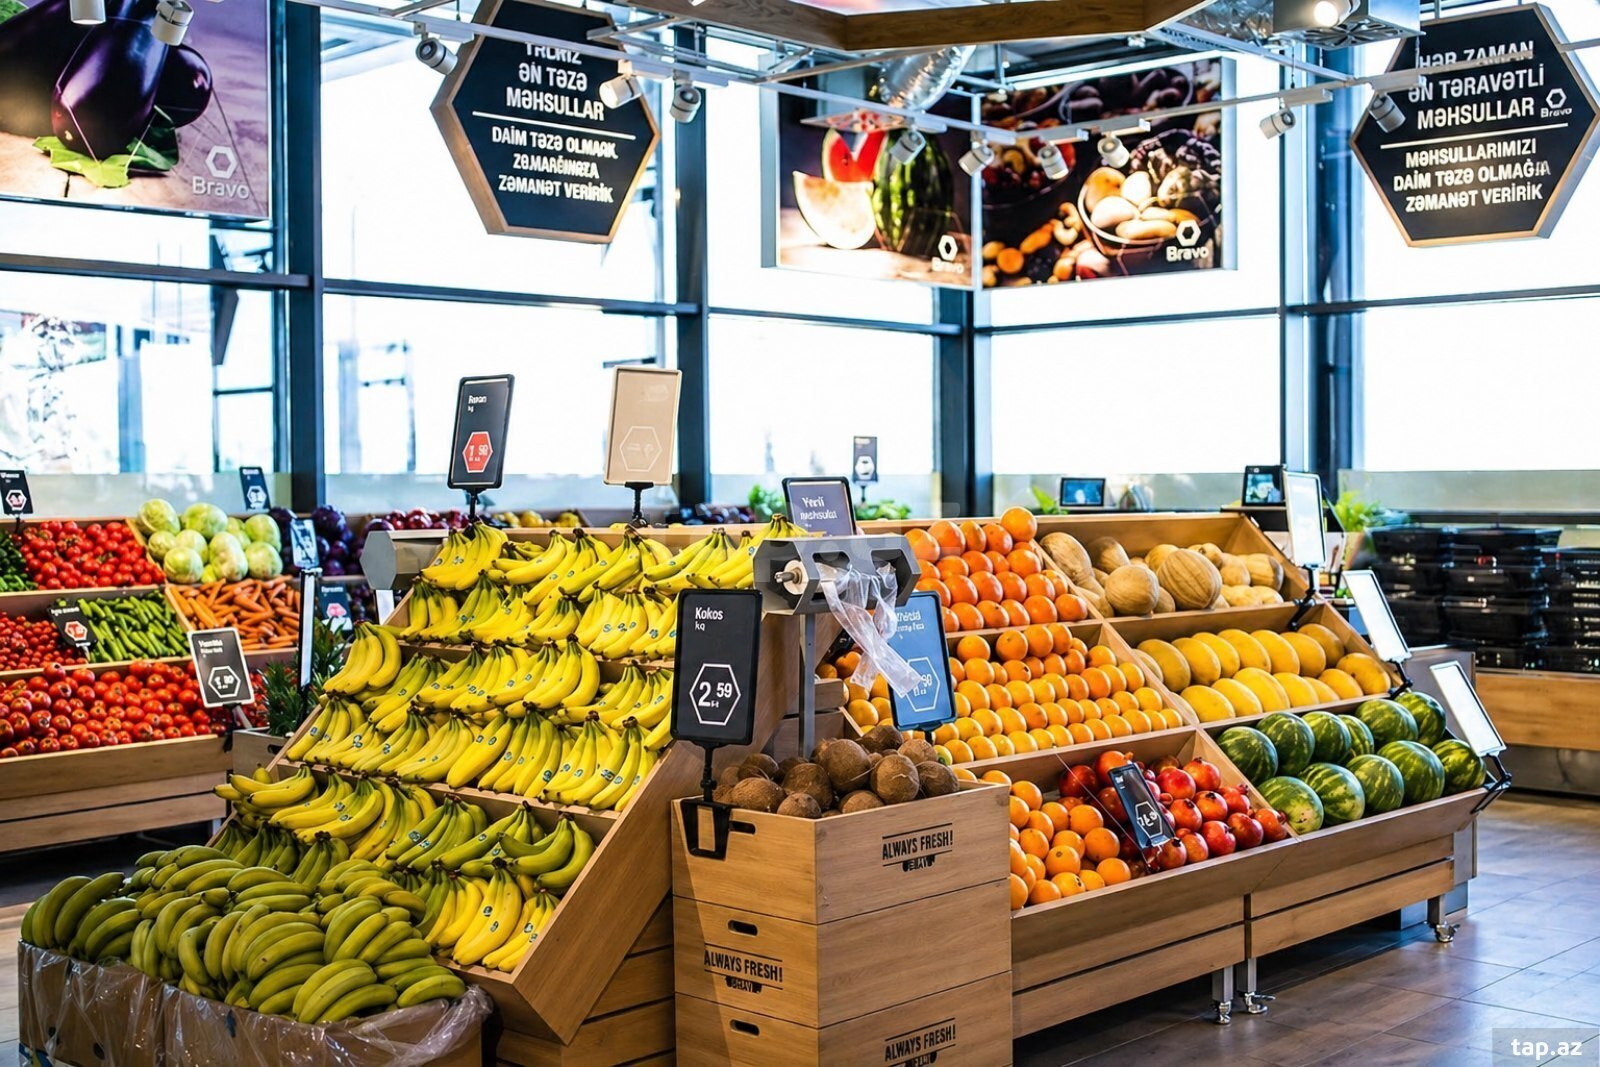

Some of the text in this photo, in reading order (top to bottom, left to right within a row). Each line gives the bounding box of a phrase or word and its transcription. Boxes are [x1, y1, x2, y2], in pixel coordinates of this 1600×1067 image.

[546, 67, 587, 91] TƏZƏ
[1439, 63, 1544, 98] TƏRAVƏTLİ
[506, 87, 604, 121] MƏHSULLAR
[1417, 97, 1535, 130] MƏHSULLAR
[1540, 107, 1573, 118] Bravo
[492, 126, 527, 146] DAİM
[530, 131, 563, 151] TƏZƏ
[1406, 138, 1536, 168] MƏHSULLARIMIZI
[192, 176, 250, 199] Bravo
[499, 175, 614, 203] ZƏMANƏT VERİRİK
[1393, 170, 1431, 192] DAİM
[1435, 168, 1474, 188] TƏZƏ
[1406, 183, 1543, 212] ZƏMANƏT VERİRİK
[1166, 245, 1209, 261] Bravo
[695, 607, 723, 620] Kokos
[695, 621, 705, 631] kq
[882, 830, 953, 860] ALWAYS FRESH!
[704, 950, 783, 982] ALWAYS FRESH!
[885, 1036, 922, 1062] ALWAYS
[924, 1024, 956, 1049] FRESH!
